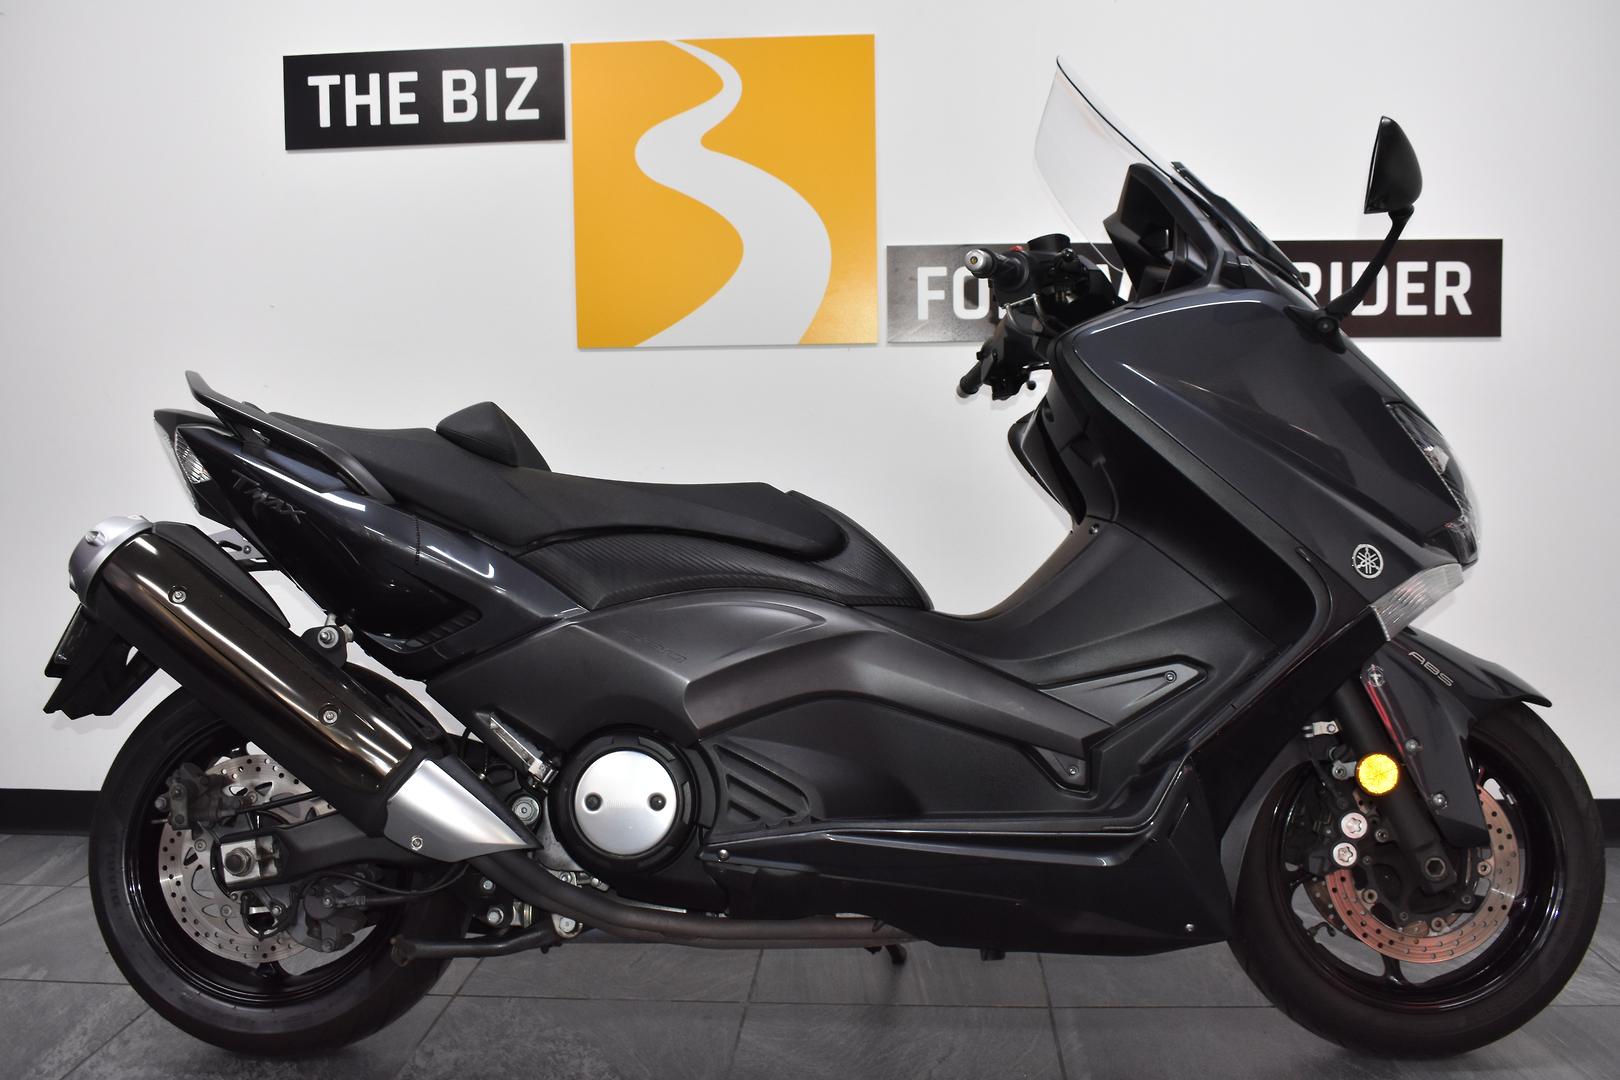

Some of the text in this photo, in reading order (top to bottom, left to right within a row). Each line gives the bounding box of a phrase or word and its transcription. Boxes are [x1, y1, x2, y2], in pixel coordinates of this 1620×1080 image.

[307, 66, 540, 128] THE BIZ
[917, 265, 1008, 320] FO
[1408, 651, 1454, 687] ABS
